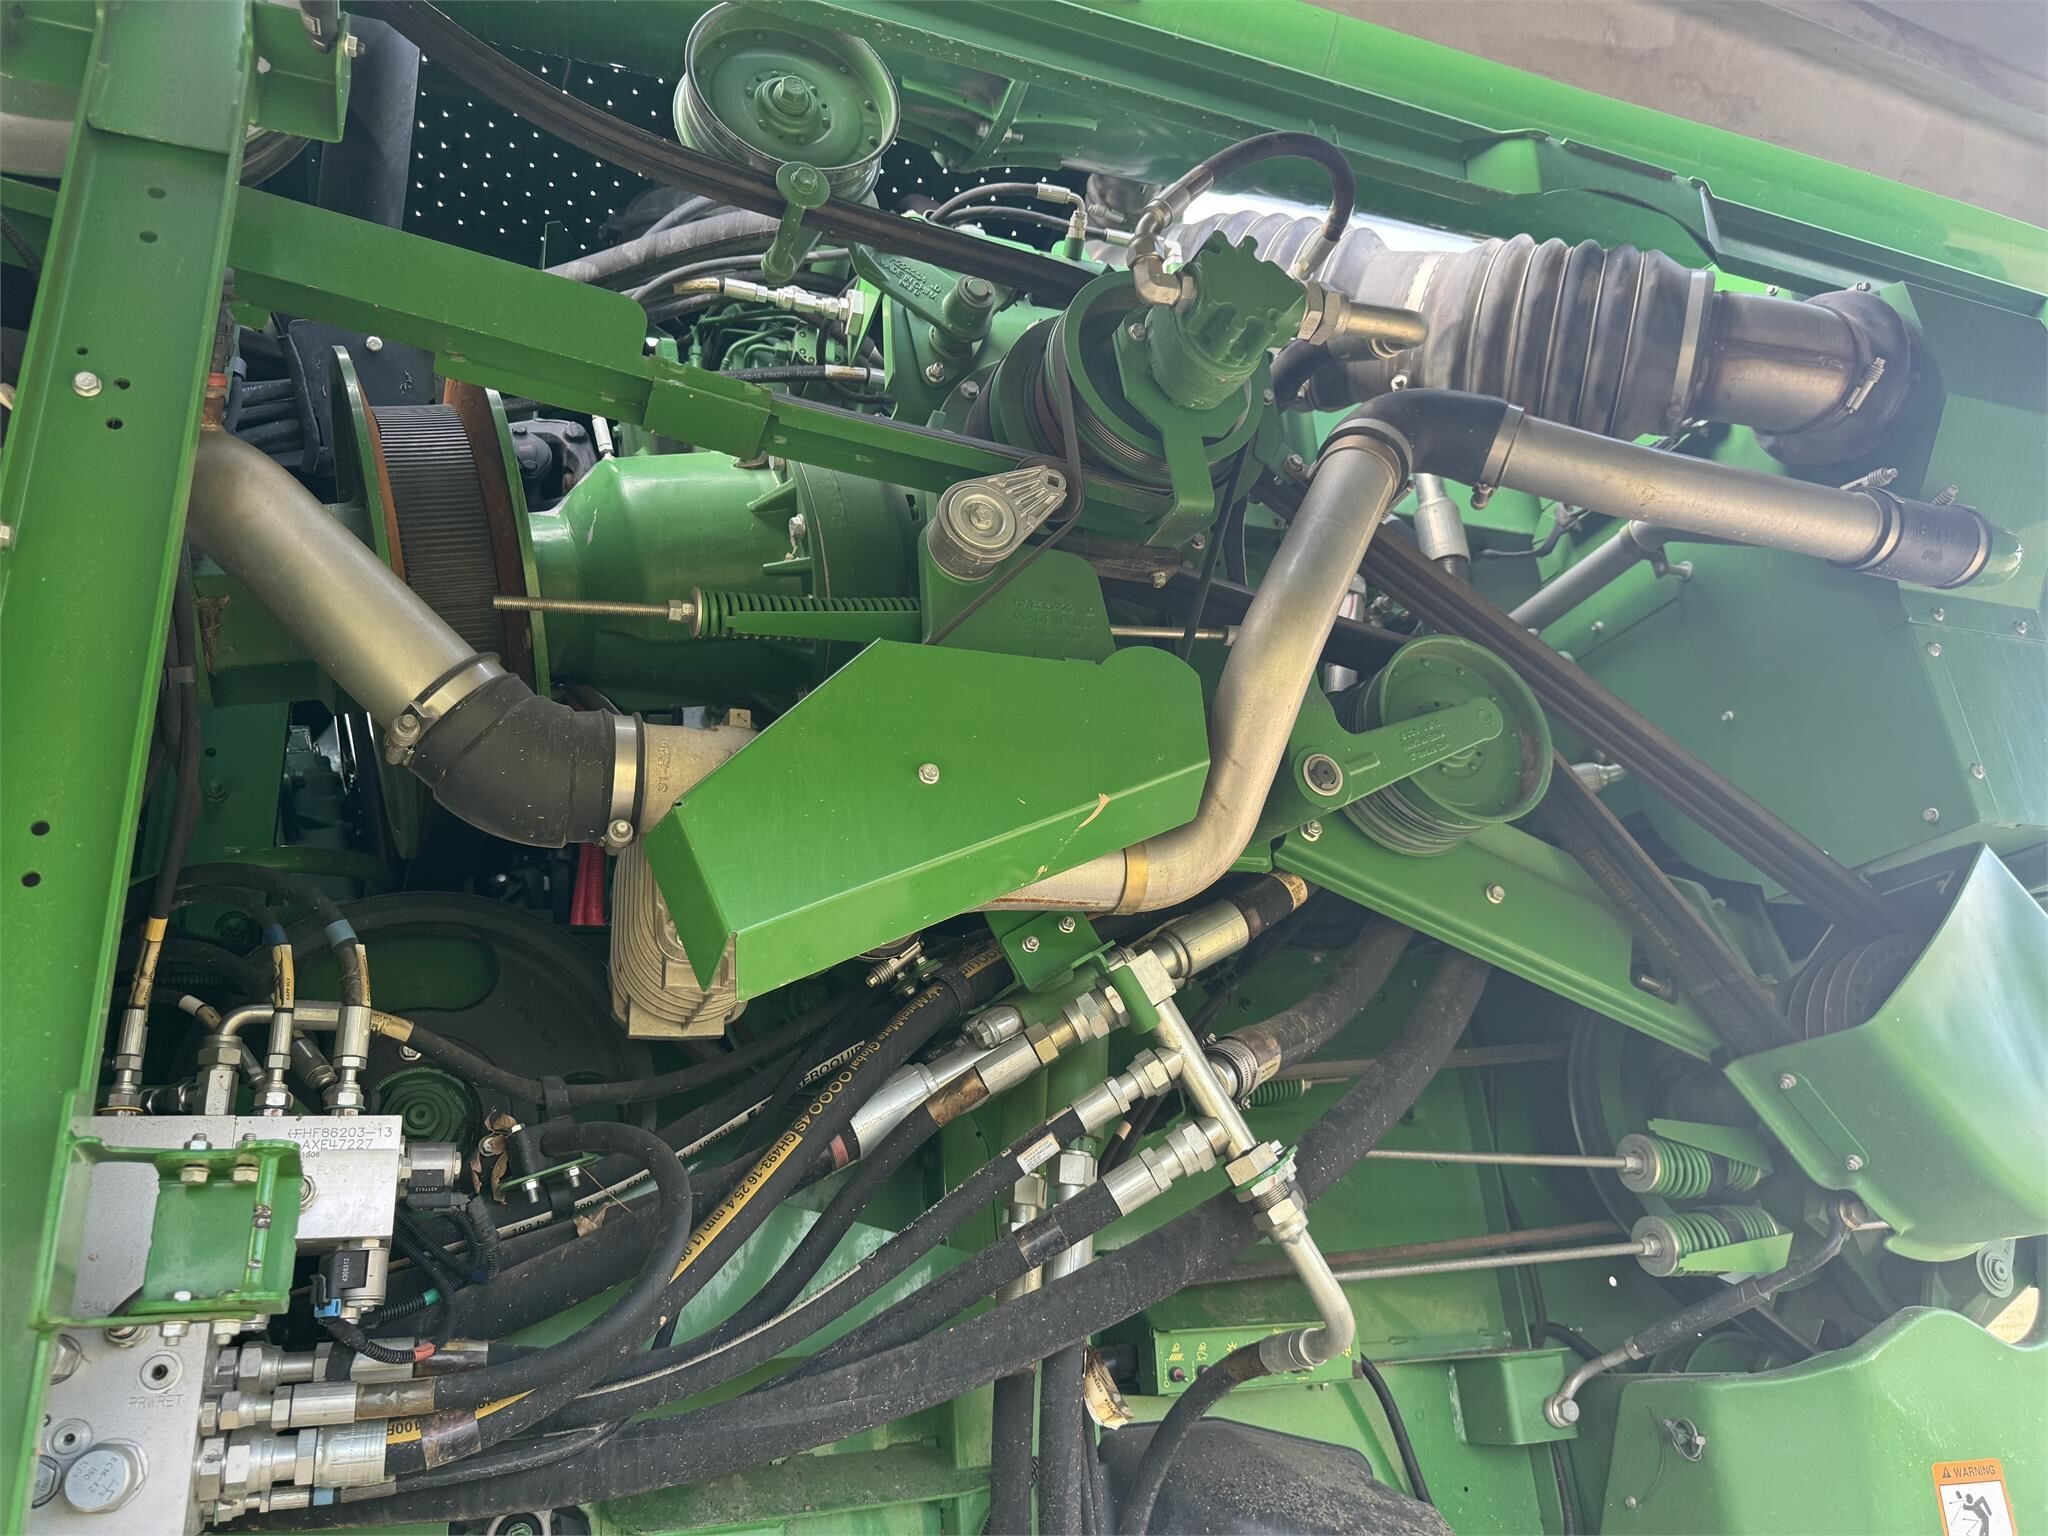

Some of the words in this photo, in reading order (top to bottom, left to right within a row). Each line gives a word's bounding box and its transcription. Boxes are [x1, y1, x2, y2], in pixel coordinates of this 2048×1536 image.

[850, 1040, 881, 1072] Global
[794, 1115, 812, 1133] 4S
[302, 1138, 374, 1150] AXE47227
[747, 1132, 798, 1186] GH493-16
[725, 1186, 750, 1210] 25.4
[703, 1209, 726, 1232] mm
[1953, 1464, 1996, 1478] WARNING
